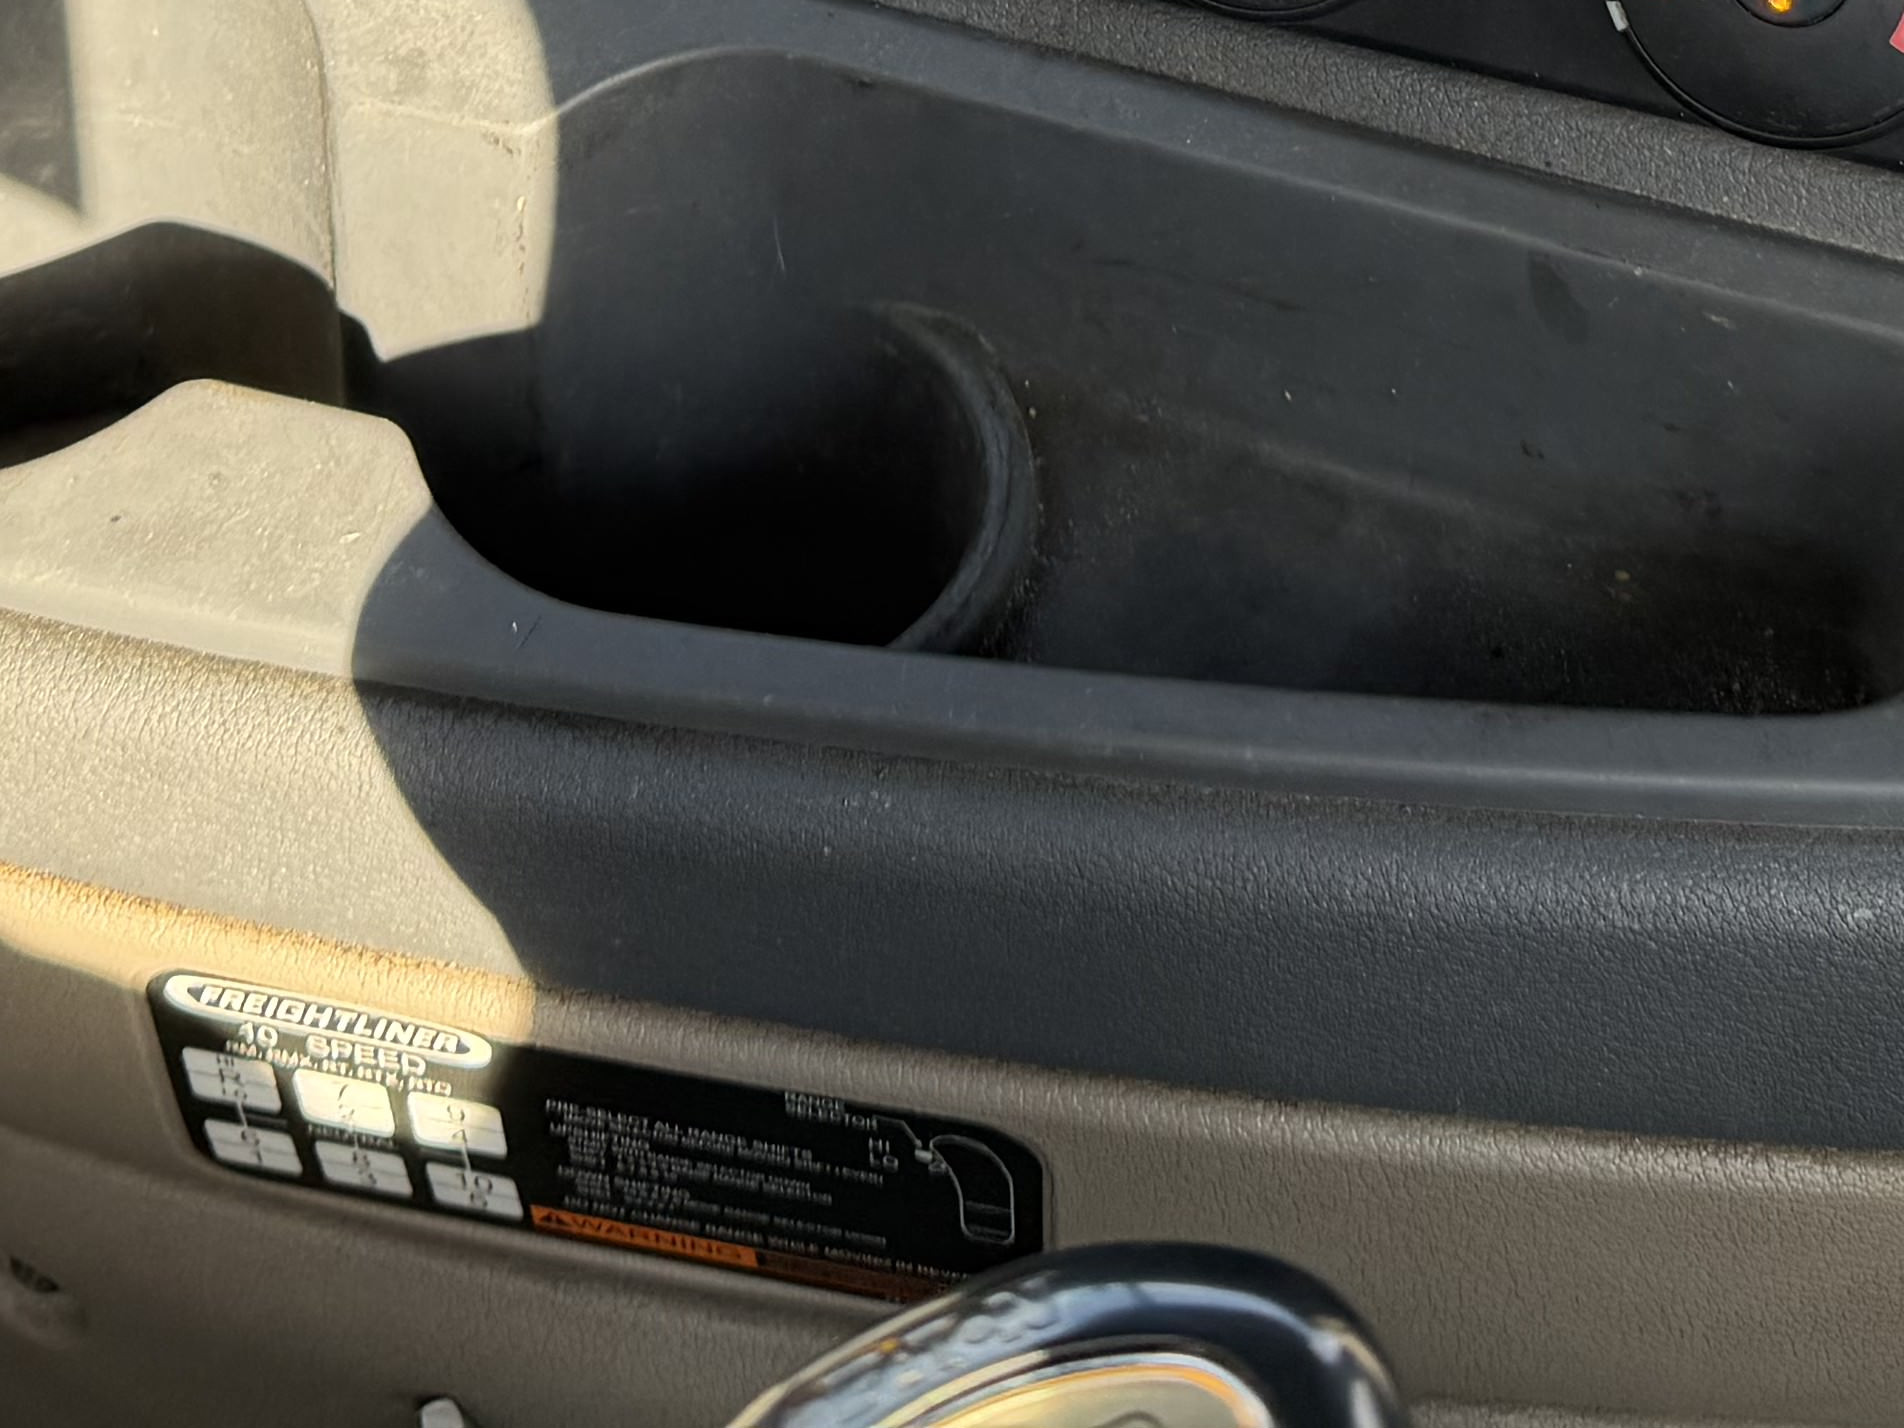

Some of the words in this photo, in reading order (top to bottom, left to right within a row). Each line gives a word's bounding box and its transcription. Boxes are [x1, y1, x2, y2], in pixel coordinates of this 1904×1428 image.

[199, 985, 461, 1053] FREIGHTLINER
[239, 1021, 278, 1048] 10
[306, 1033, 427, 1077] SPEED
[572, 1215, 743, 1260] WARNING
